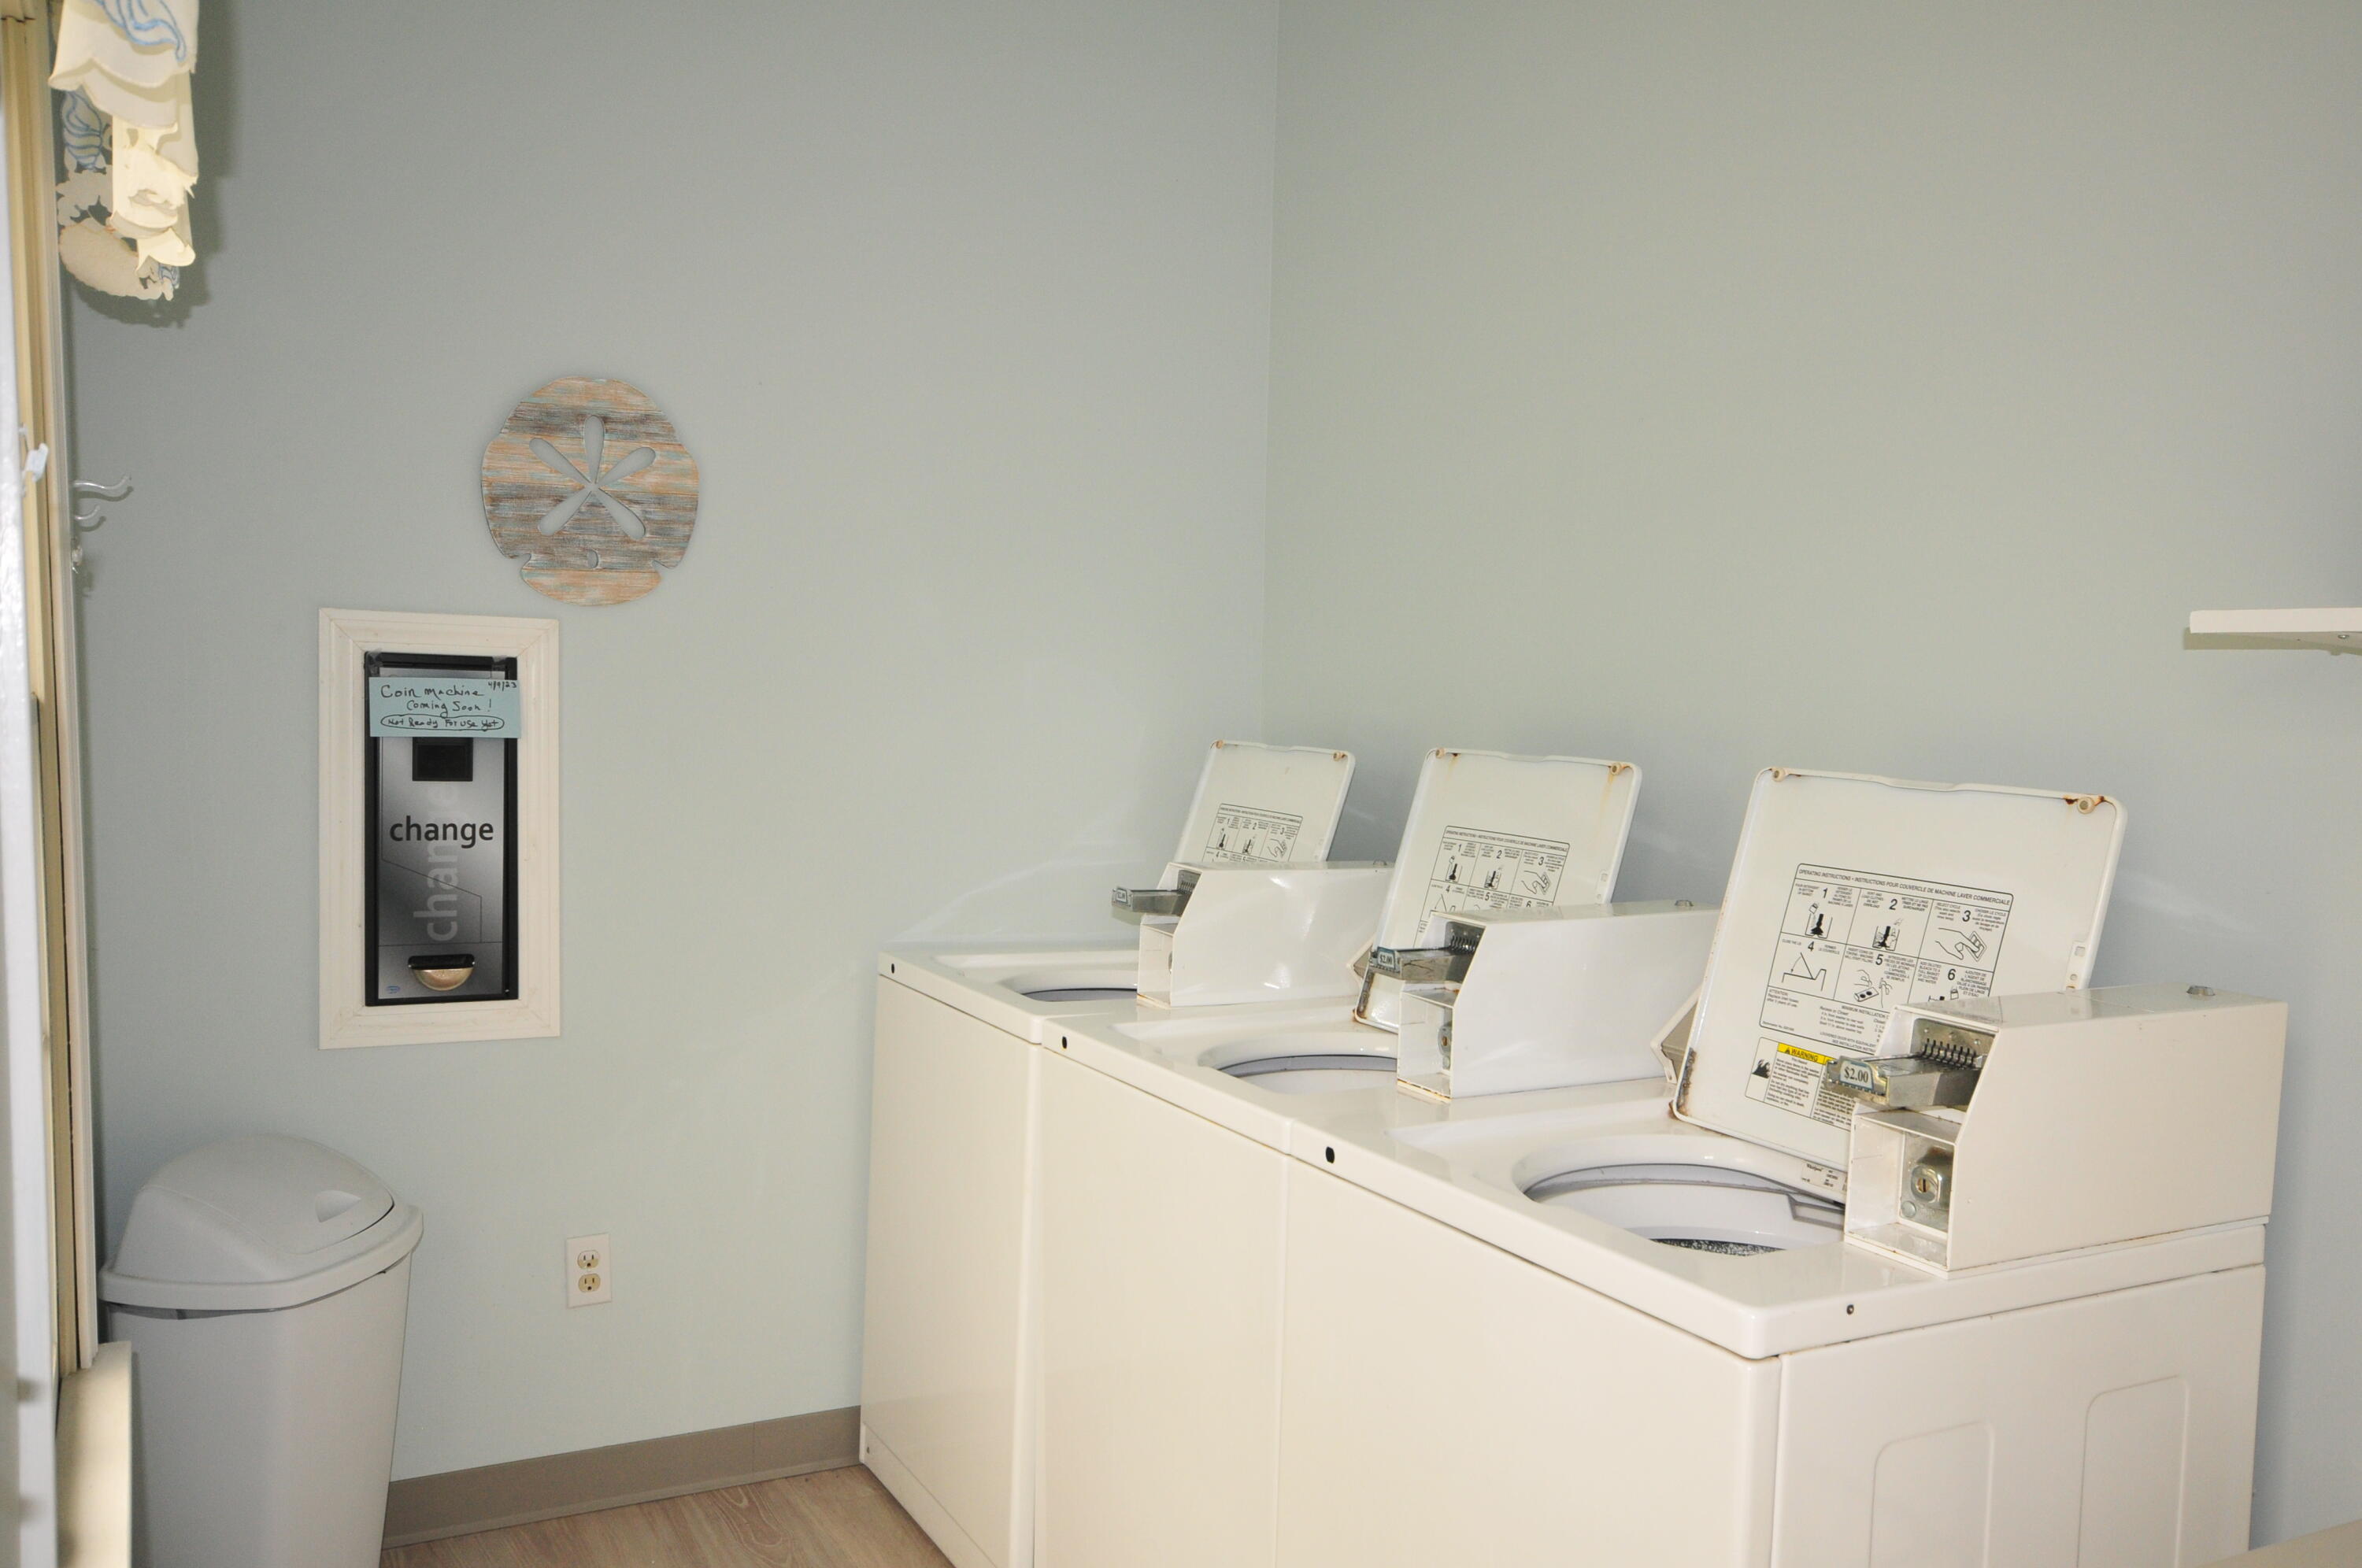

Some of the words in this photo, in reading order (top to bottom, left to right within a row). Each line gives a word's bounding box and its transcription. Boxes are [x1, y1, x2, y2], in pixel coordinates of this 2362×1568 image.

[381, 685, 422, 698] Coin
[389, 815, 494, 849] change
[1496, 850, 1502, 859] 2
[1538, 856, 1544, 866] 3
[1823, 888, 1827, 898] 1
[1890, 899, 1897, 910] 2
[1962, 910, 1971, 922] 3
[1808, 941, 1814, 952] 4
[1875, 954, 1883, 965] 5
[1948, 968, 1957, 980] 6
[1791, 1048, 1819, 1062] WARNING
[1844, 1068, 1868, 1083] $2.00
